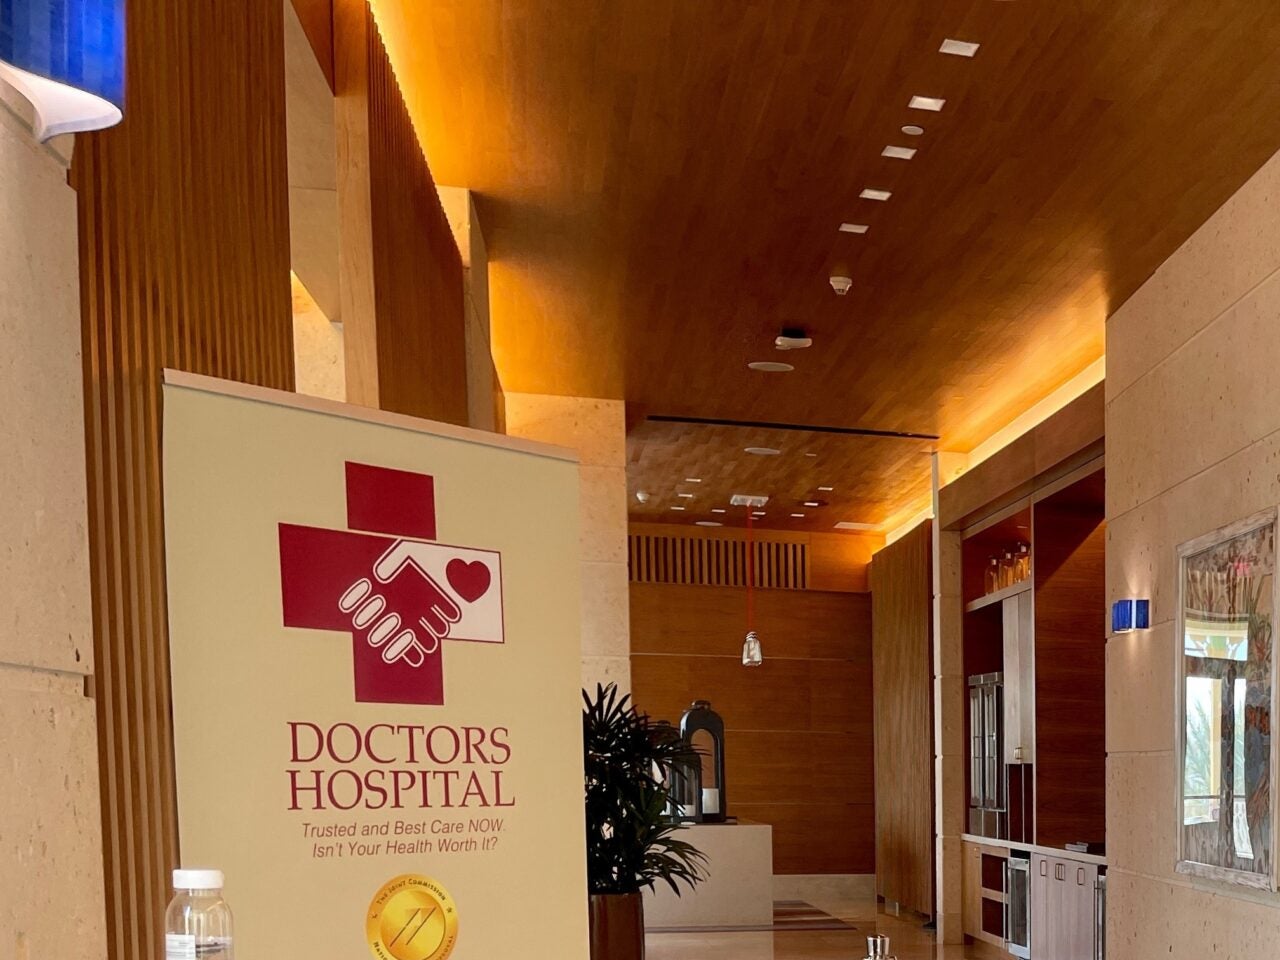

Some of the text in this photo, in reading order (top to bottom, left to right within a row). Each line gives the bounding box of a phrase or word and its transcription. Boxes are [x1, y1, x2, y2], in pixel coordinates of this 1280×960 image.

[286, 721, 511, 765] DOCTORS
[285, 770, 516, 810] HOSPITAL
[302, 822, 357, 838] Trusted
[361, 821, 389, 836] and
[393, 820, 426, 835] Best
[430, 819, 464, 834] Care
[313, 836, 498, 858] Isn't Your Health Worth It?
